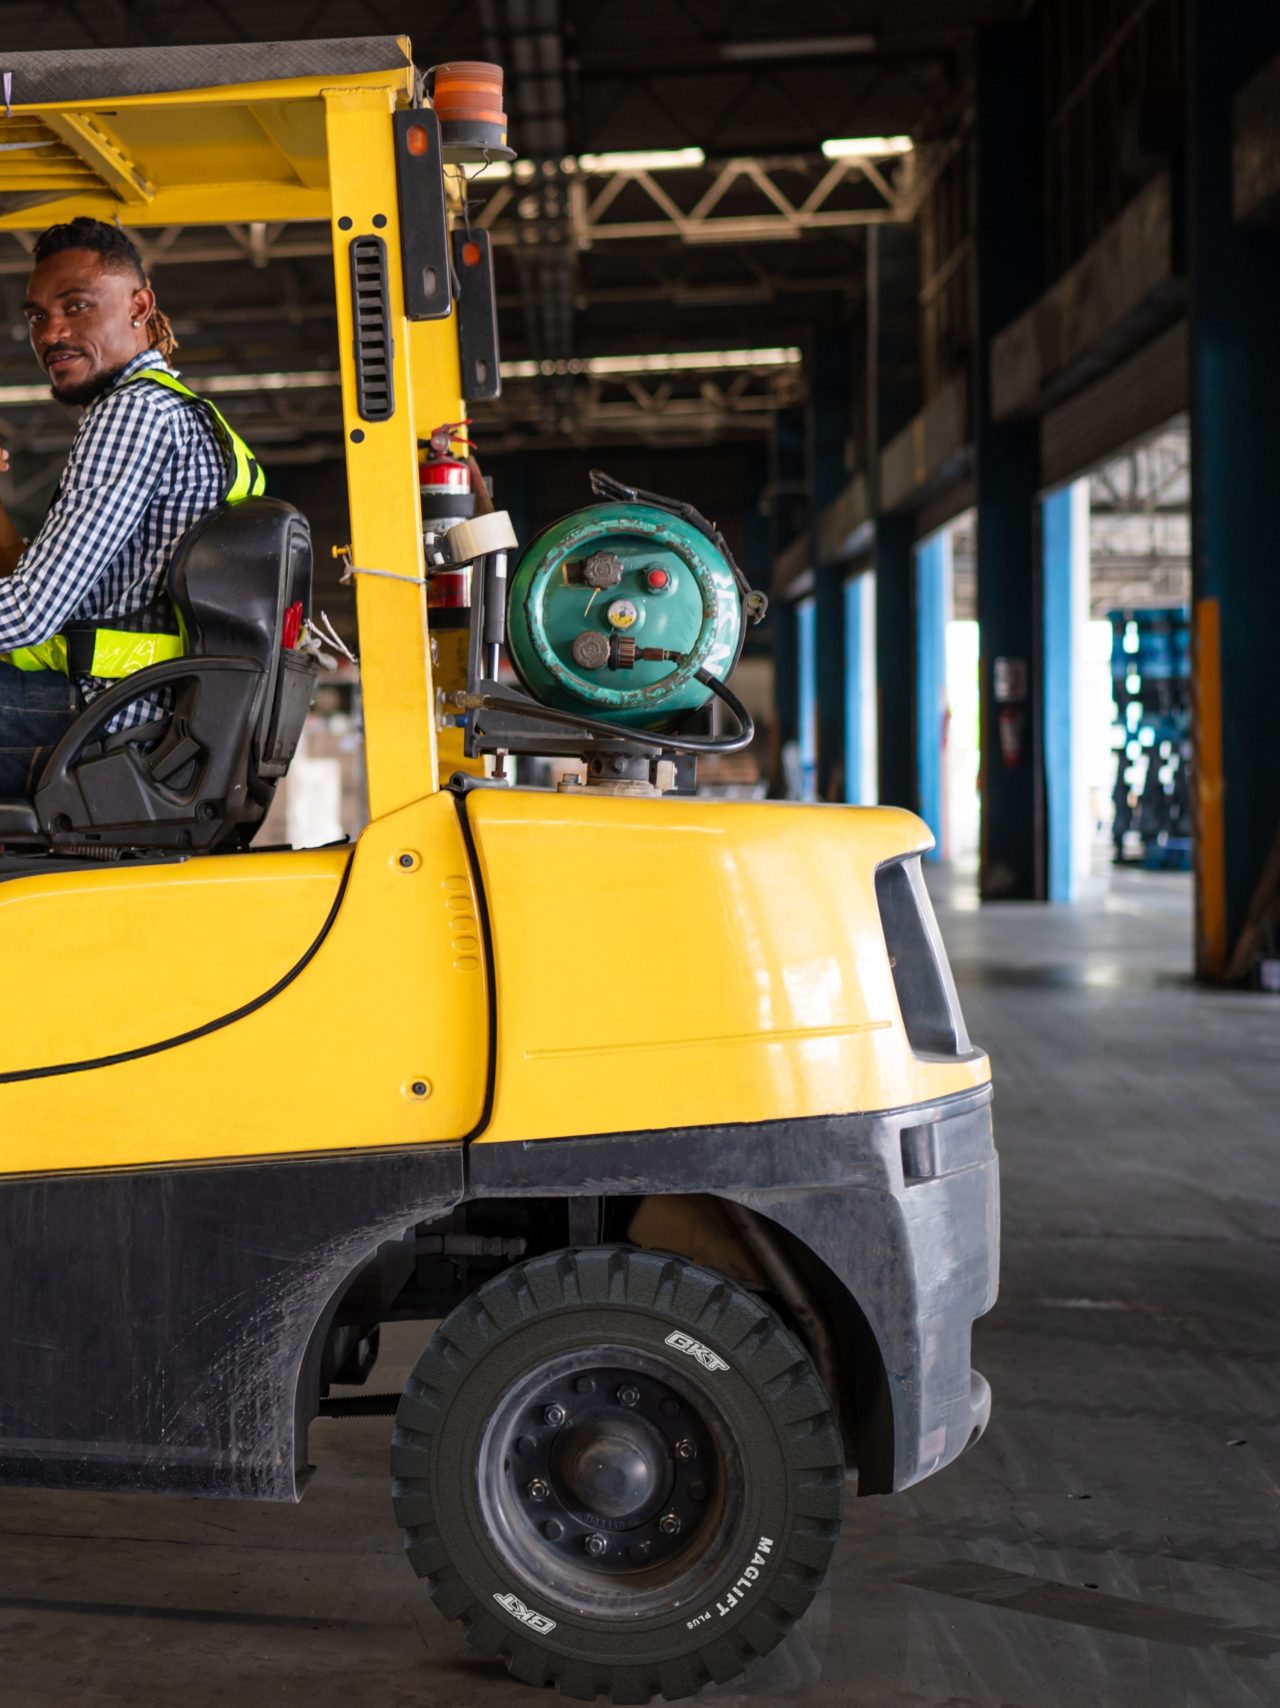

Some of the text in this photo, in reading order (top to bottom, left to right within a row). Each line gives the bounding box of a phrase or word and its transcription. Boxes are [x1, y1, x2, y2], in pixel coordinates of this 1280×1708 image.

[665, 1330, 730, 1371] BKT
[686, 1536, 774, 1630] MAGLIFT PLUS
[493, 1593, 557, 1635] BKT
